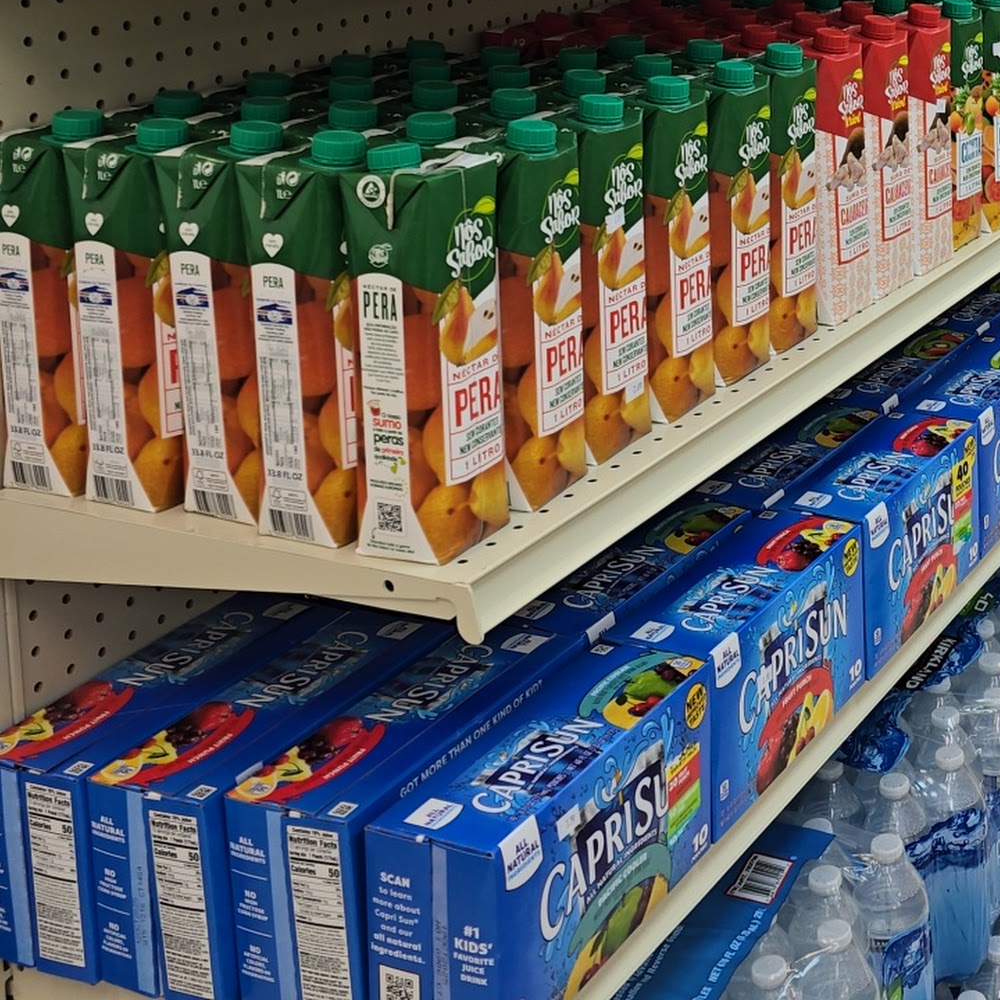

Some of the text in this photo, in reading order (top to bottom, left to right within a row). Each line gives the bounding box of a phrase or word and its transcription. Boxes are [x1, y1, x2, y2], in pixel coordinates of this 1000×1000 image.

[2, 244, 20, 258] PERA
[85, 252, 104, 266] PERA
[180, 262, 200, 276] PERA
[263, 275, 284, 289] PERA
[679, 266, 710, 310] PERA
[363, 291, 398, 321] PERA
[610, 297, 647, 344] PERA
[546, 329, 584, 382] PERA
[623, 360, 646, 378] LITRO
[455, 371, 500, 427] PERA
[560, 399, 582, 419] LITRO
[372, 418, 402, 430] sumo
[373, 433, 404, 446] peras
[472, 443, 500, 466] LITRO
[957, 461, 968, 481] 40
[974, 592, 994, 612] 40
[717, 650, 739, 673] NATURAL
[722, 647, 732, 661] ALL
[849, 660, 862, 680] 10
[797, 674, 812, 693] PUNCH
[687, 689, 704, 709] NEW
[400, 778, 420, 797] GOT
[420, 758, 448, 782] MORE
[448, 738, 473, 760] THAN
[473, 722, 492, 741] ONE
[492, 705, 513, 725] KIND
[513, 696, 525, 710] OF
[28, 792, 71, 807] Nutrition Facts
[100, 815, 114, 826] ALL
[424, 803, 453, 828] NATURAL
[426, 808, 440, 819] ALL
[29, 819, 72, 834] Calories 50
[91, 821, 125, 837] NATURAL
[151, 819, 196, 834] Nutrition Facts
[238, 836, 253, 847] ALL
[289, 836, 337, 849] Nutrition Facts
[692, 824, 708, 852] 10
[154, 848, 199, 862] Calories 50
[229, 842, 266, 858] NATURAL
[515, 838, 528, 856] ALL
[507, 842, 540, 873] NATURAL
[104, 868, 116, 878] NO
[291, 865, 340, 879] Calories 50
[380, 871, 410, 888] SCAN
[598, 852, 648, 907] PACIFIC COOLER
[586, 888, 597, 904] ALL
[597, 857, 624, 887] NATURAL
[244, 890, 257, 900] NO
[379, 886, 413, 901] to learn
[372, 896, 421, 915] more about
[374, 908, 397, 924] Capri
[108, 921, 119, 931] NO
[380, 922, 413, 938] and our
[463, 925, 480, 939] #1
[249, 944, 261, 954] NO
[373, 931, 422, 951] all natural
[454, 937, 493, 955] KIDS'
[370, 942, 426, 965] ingredients.
[453, 951, 495, 966] FAVORITE
[708, 968, 721, 983] NET
[729, 939, 742, 951] OZ
[461, 963, 485, 976] JUICE
[460, 974, 488, 987] DRINK
